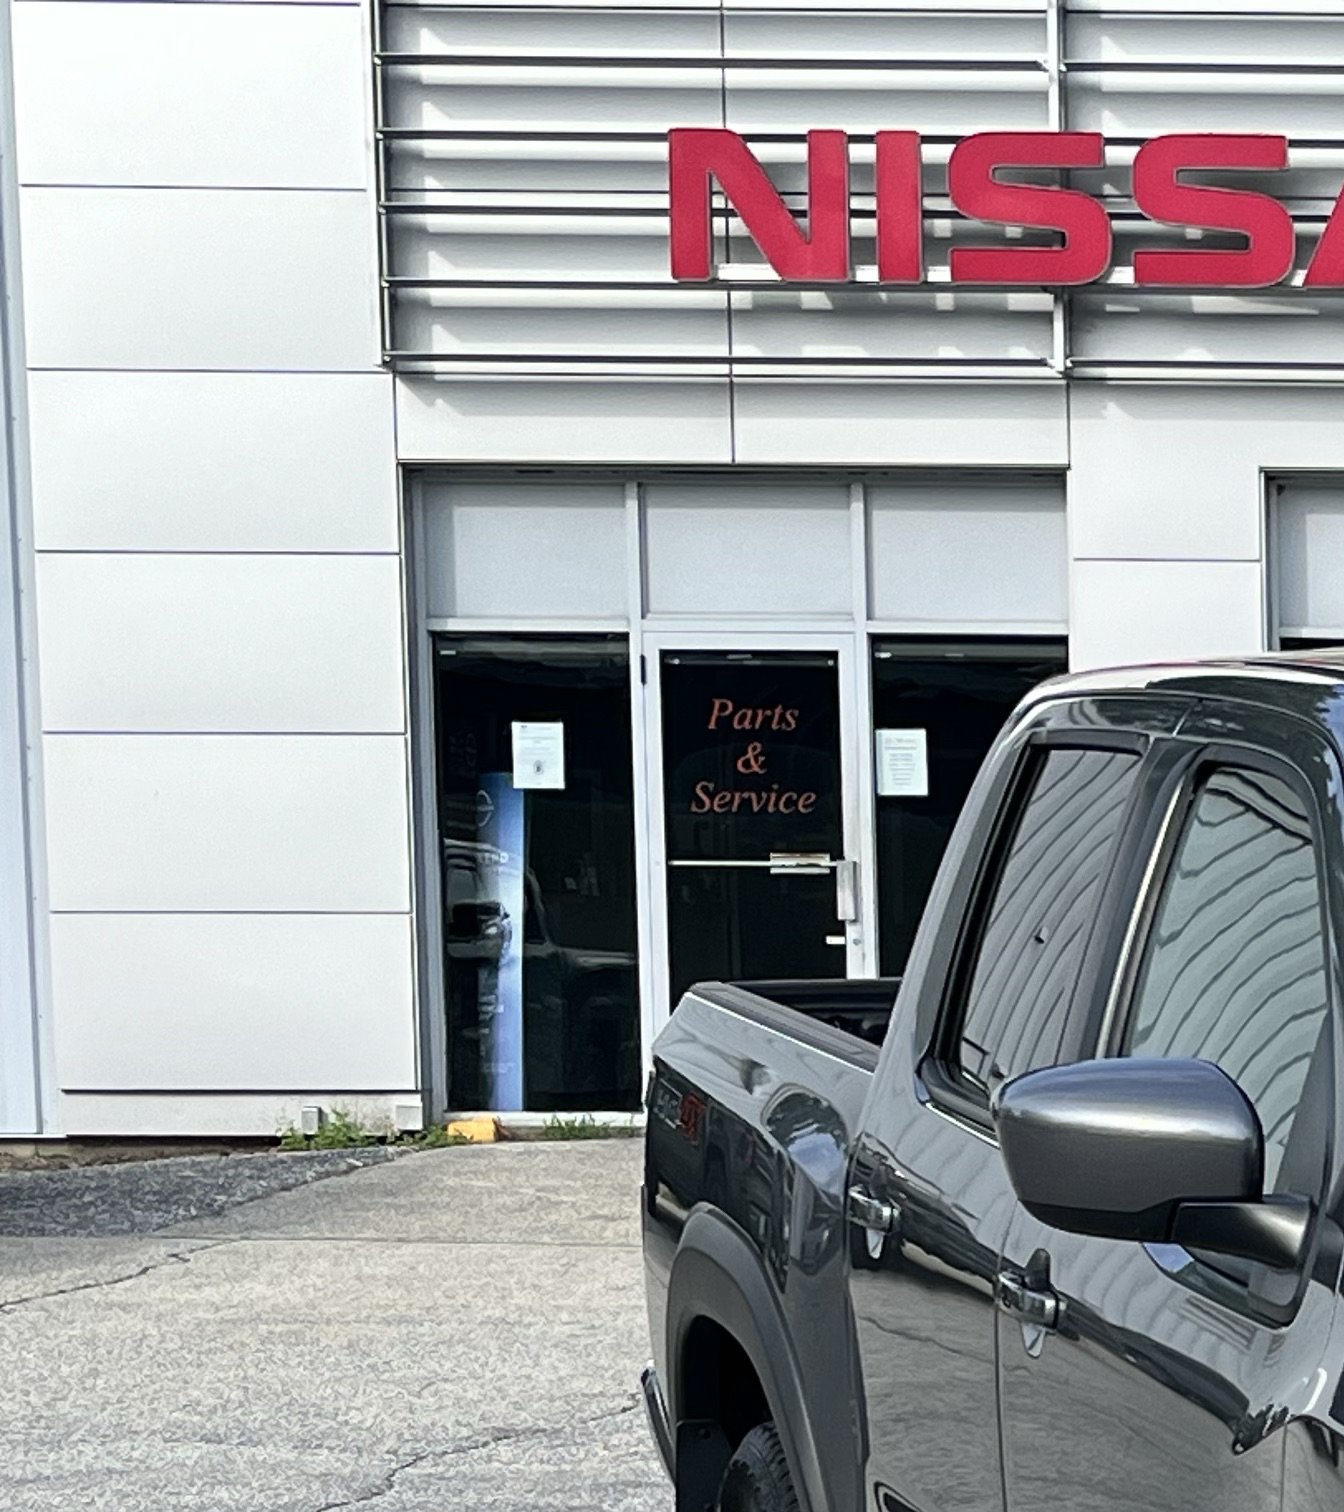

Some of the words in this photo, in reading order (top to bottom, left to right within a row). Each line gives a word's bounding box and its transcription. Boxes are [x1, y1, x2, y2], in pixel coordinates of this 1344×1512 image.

[707, 698, 800, 731] Parts
[736, 741, 768, 775] &
[690, 781, 817, 814] Service
